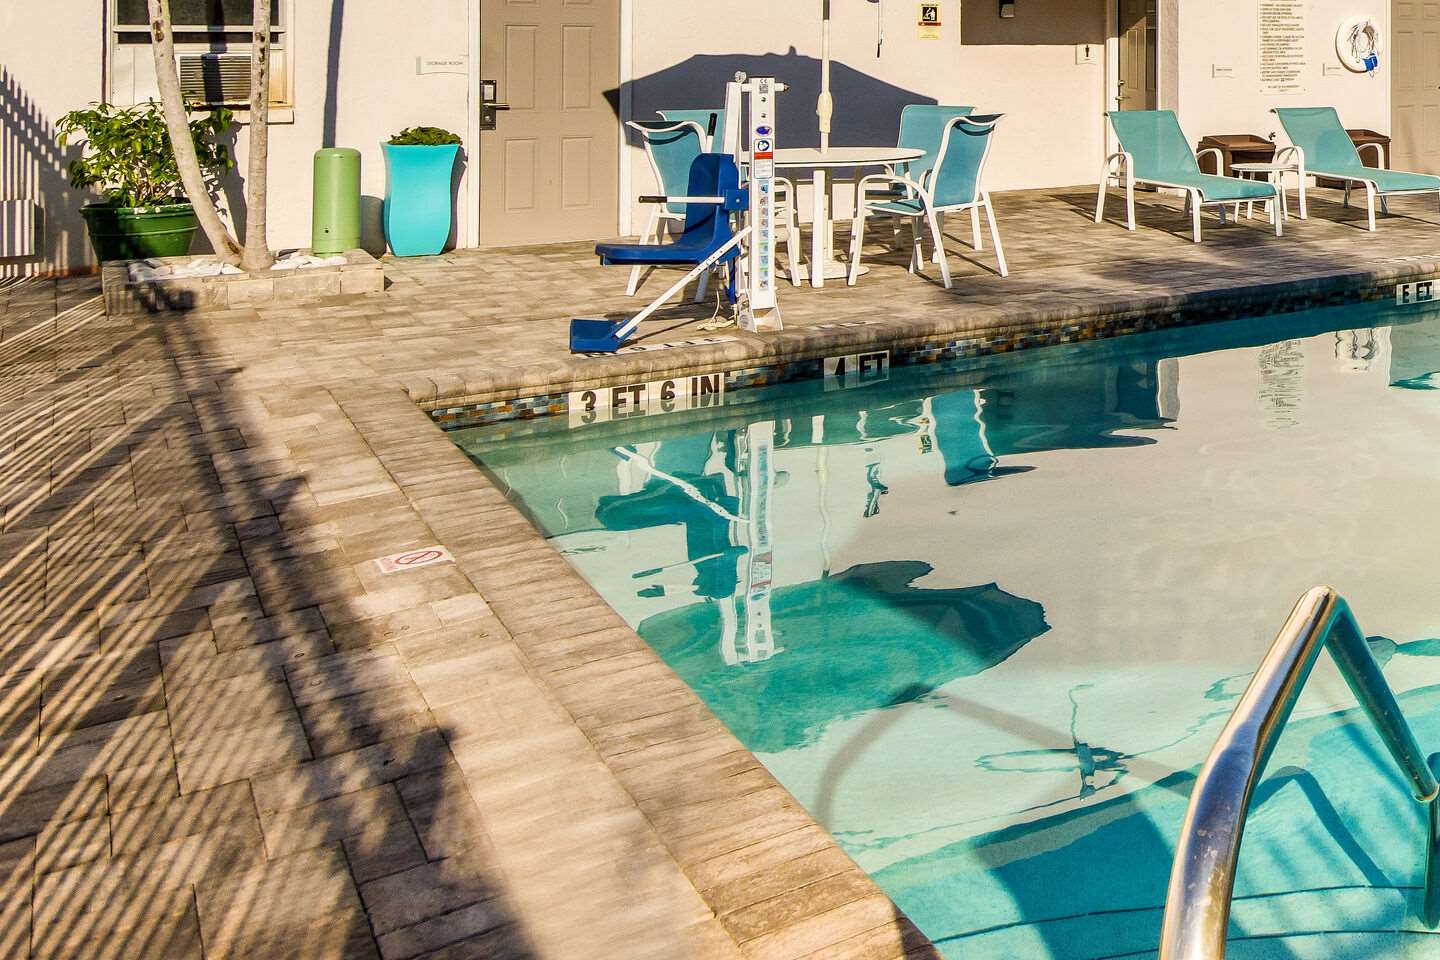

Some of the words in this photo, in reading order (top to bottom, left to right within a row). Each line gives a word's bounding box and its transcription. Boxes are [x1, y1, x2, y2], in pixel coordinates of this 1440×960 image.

[859, 352, 888, 373] FT
[580, 390, 598, 412] 3
[611, 383, 647, 408] FT
[660, 380, 677, 401] 6
[691, 374, 720, 397] IN
